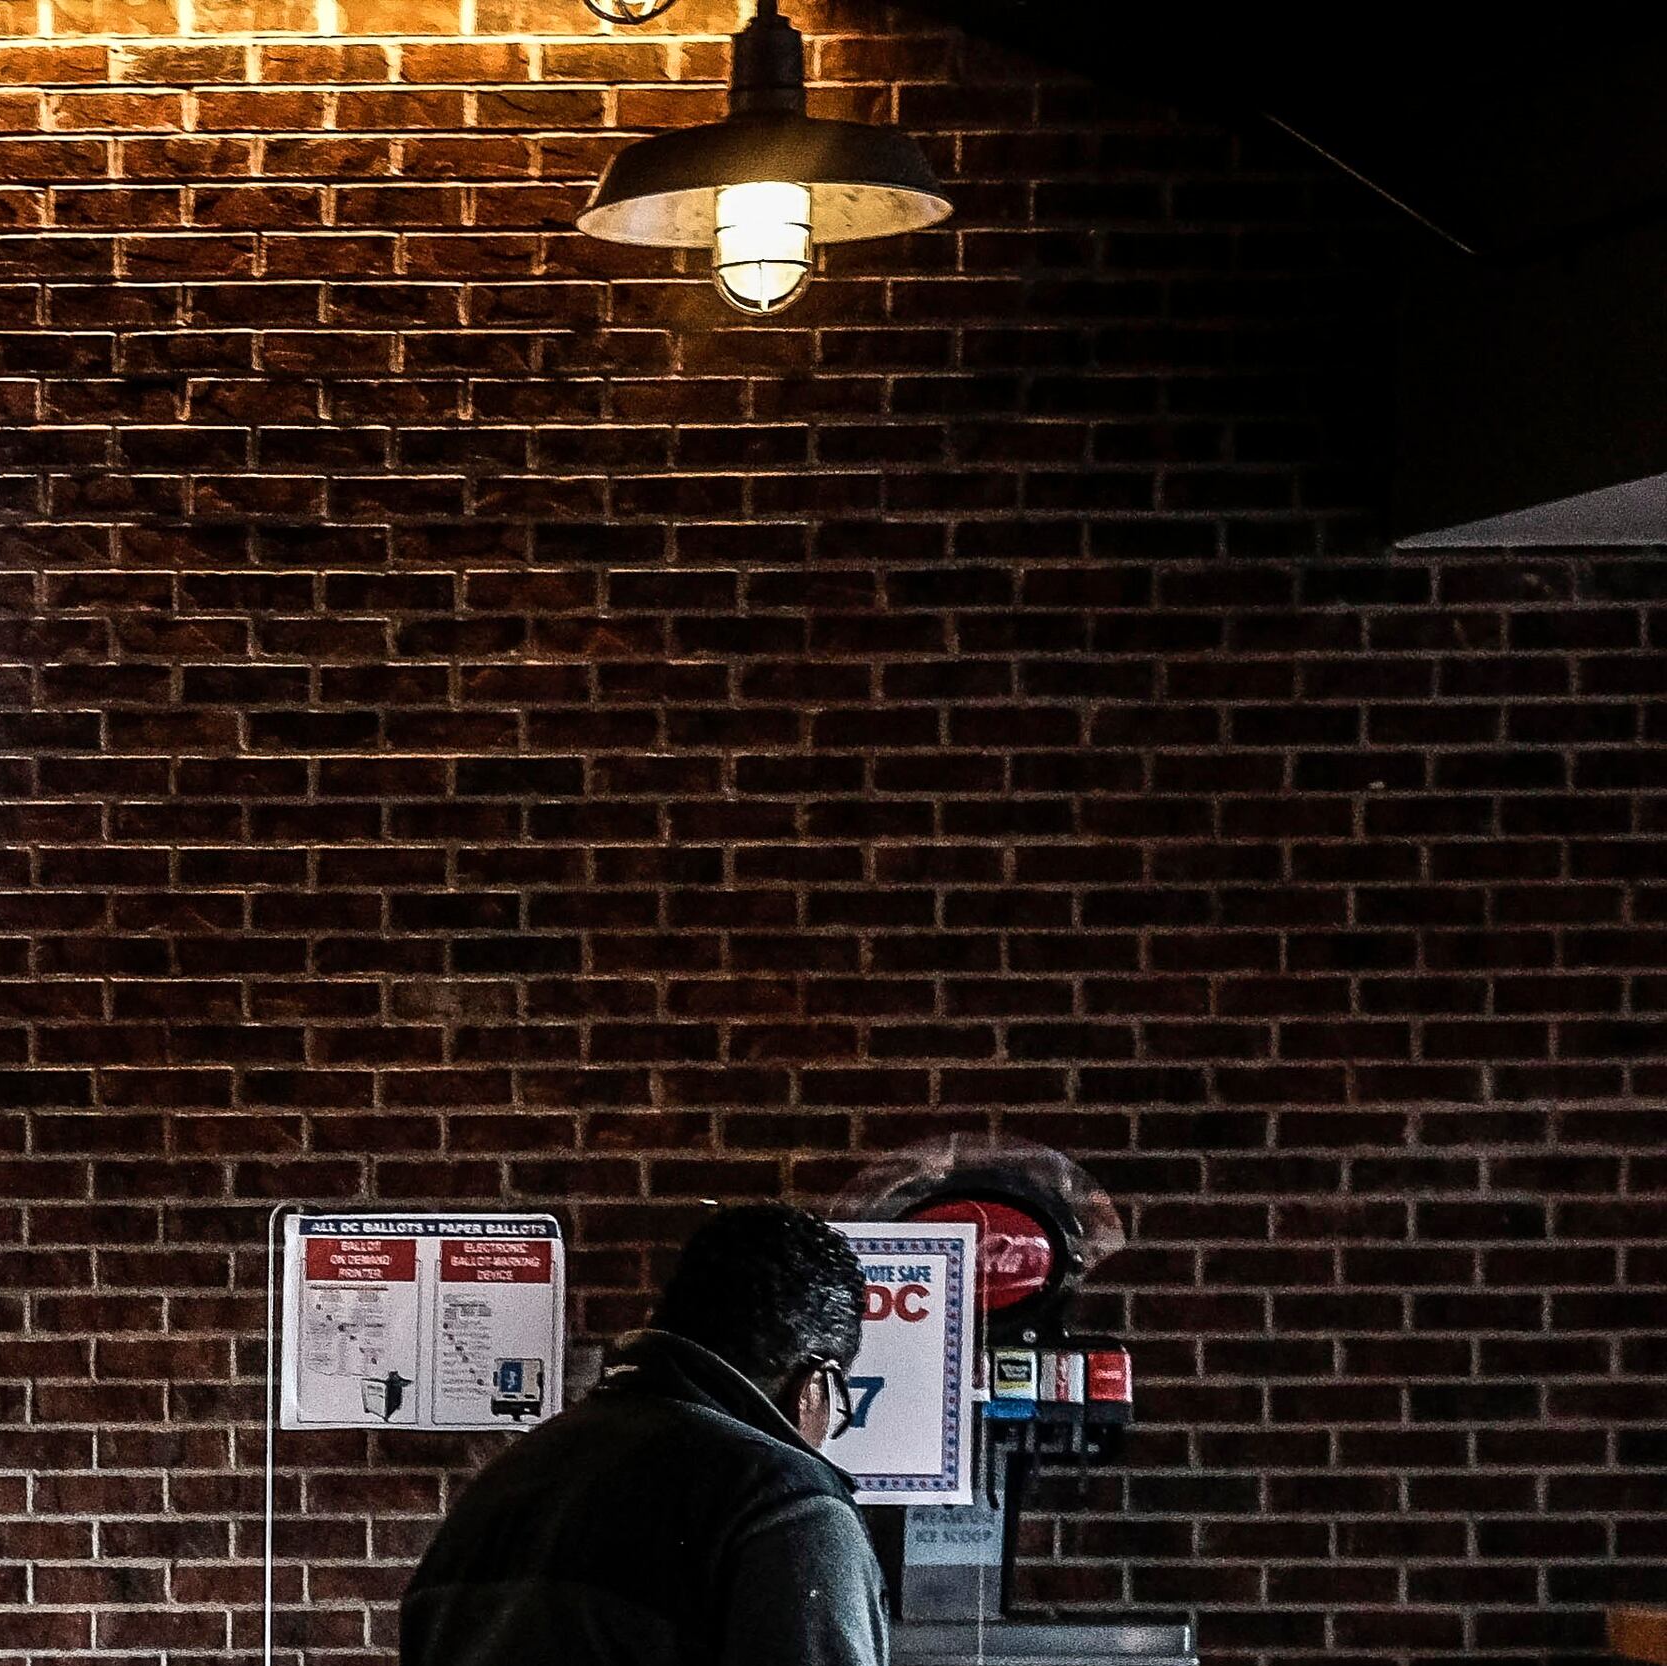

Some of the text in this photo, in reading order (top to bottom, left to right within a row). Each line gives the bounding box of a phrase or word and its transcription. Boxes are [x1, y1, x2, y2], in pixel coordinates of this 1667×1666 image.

[311, 1222, 337, 1232] ALL
[340, 1222, 360, 1233] DC
[363, 1222, 424, 1233] BALLOTS
[439, 1223, 483, 1234] PAPER
[486, 1223, 547, 1234] BALLOTS
[340, 1241, 382, 1252] BALLOT
[464, 1242, 529, 1253] ELECTRONIC
[348, 1255, 391, 1266] DEMAND
[477, 1270, 513, 1281] DEVICE
[897, 1265, 931, 1282] SAFE
[861, 1284, 930, 1322] DC
[848, 1377, 884, 1427] 7
